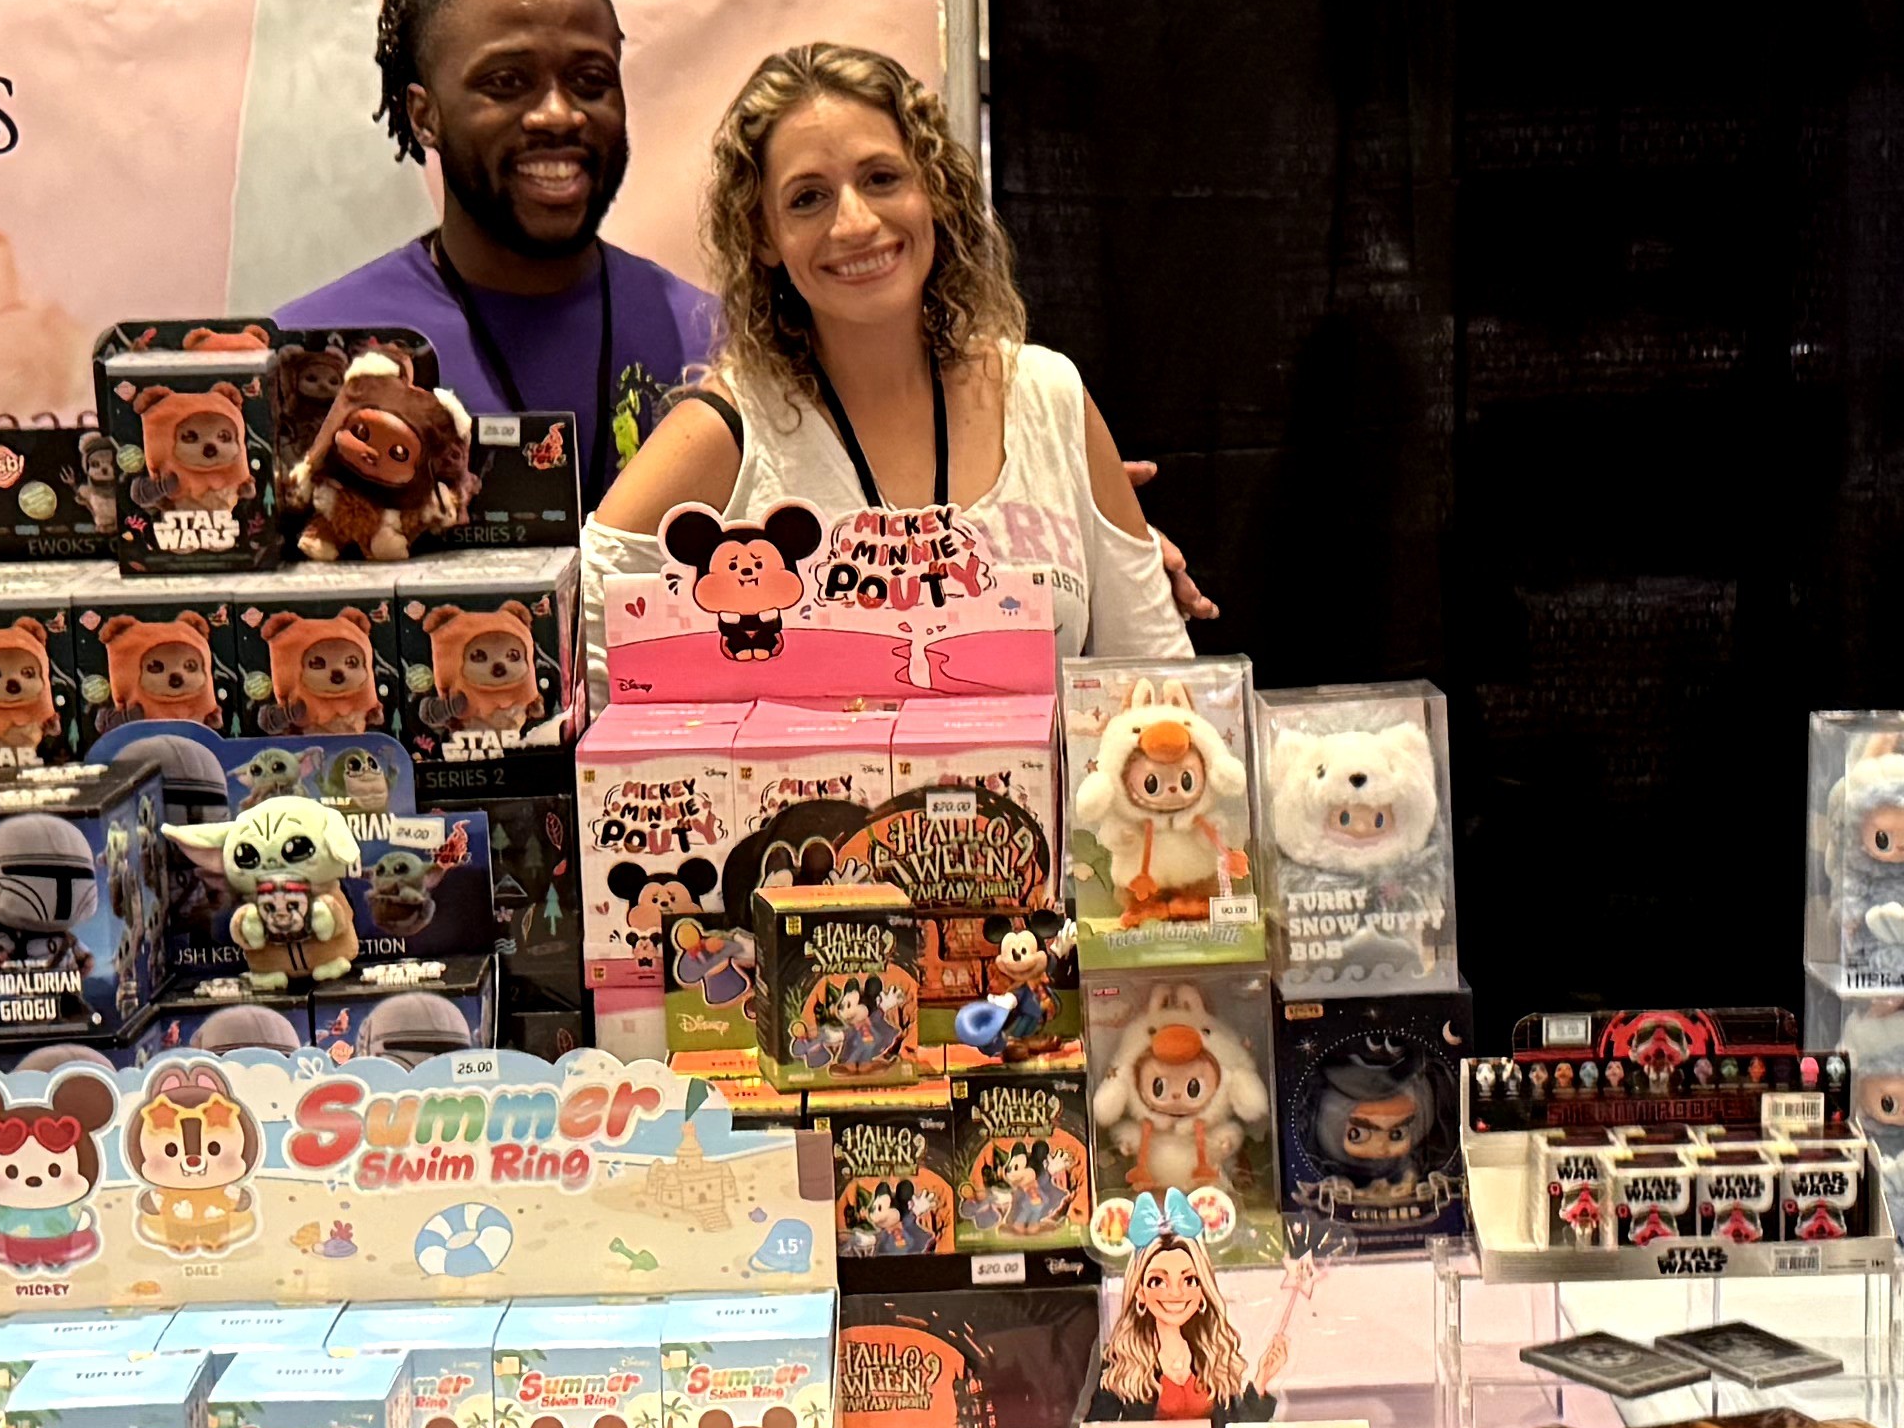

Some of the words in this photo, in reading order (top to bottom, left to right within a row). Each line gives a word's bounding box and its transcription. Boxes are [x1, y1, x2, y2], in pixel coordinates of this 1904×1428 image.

[162, 509, 237, 530] STAR
[854, 507, 955, 538] MICKEY
[153, 528, 240, 551] WARS
[454, 526, 510, 543] SERIES
[515, 525, 527, 542] 2
[28, 538, 95, 557] EWOKS
[851, 535, 960, 567] MINNIE
[825, 555, 982, 612] POUTY
[618, 677, 654, 693] Disney
[441, 730, 526, 751] STAR
[426, 769, 488, 789] SERIES
[493, 767, 506, 786] 2
[778, 776, 853, 797] MICKEY
[621, 778, 696, 800] MICKEY
[620, 800, 700, 822] MINNIE
[599, 817, 722, 855] POUTY
[1286, 888, 1371, 913] FURRY
[1287, 913, 1358, 939] SNOW
[1362, 908, 1447, 933] PUPPY
[1290, 939, 1344, 962] BOB
[0, 998, 57, 1022] GROGU
[676, 1012, 731, 1038] Disney
[457, 1059, 493, 1076] 25.00
[290, 1077, 664, 1169] Summer
[359, 1148, 475, 1188] Swim
[490, 1142, 590, 1190] Ring
[1629, 1175, 1681, 1192] STAR
[1712, 1173, 1764, 1189] STAR
[1796, 1171, 1848, 1186] STAR
[1624, 1187, 1682, 1203] WARS
[1708, 1185, 1765, 1201] WARS
[1790, 1182, 1849, 1198] WARS
[1666, 1245, 1728, 1262] STAR
[978, 1261, 1020, 1275] $20.00
[1656, 1258, 1729, 1275] WARS
[15, 1283, 71, 1297] MICKEY
[519, 1371, 643, 1400] Summer
[687, 1362, 810, 1394] Summer
